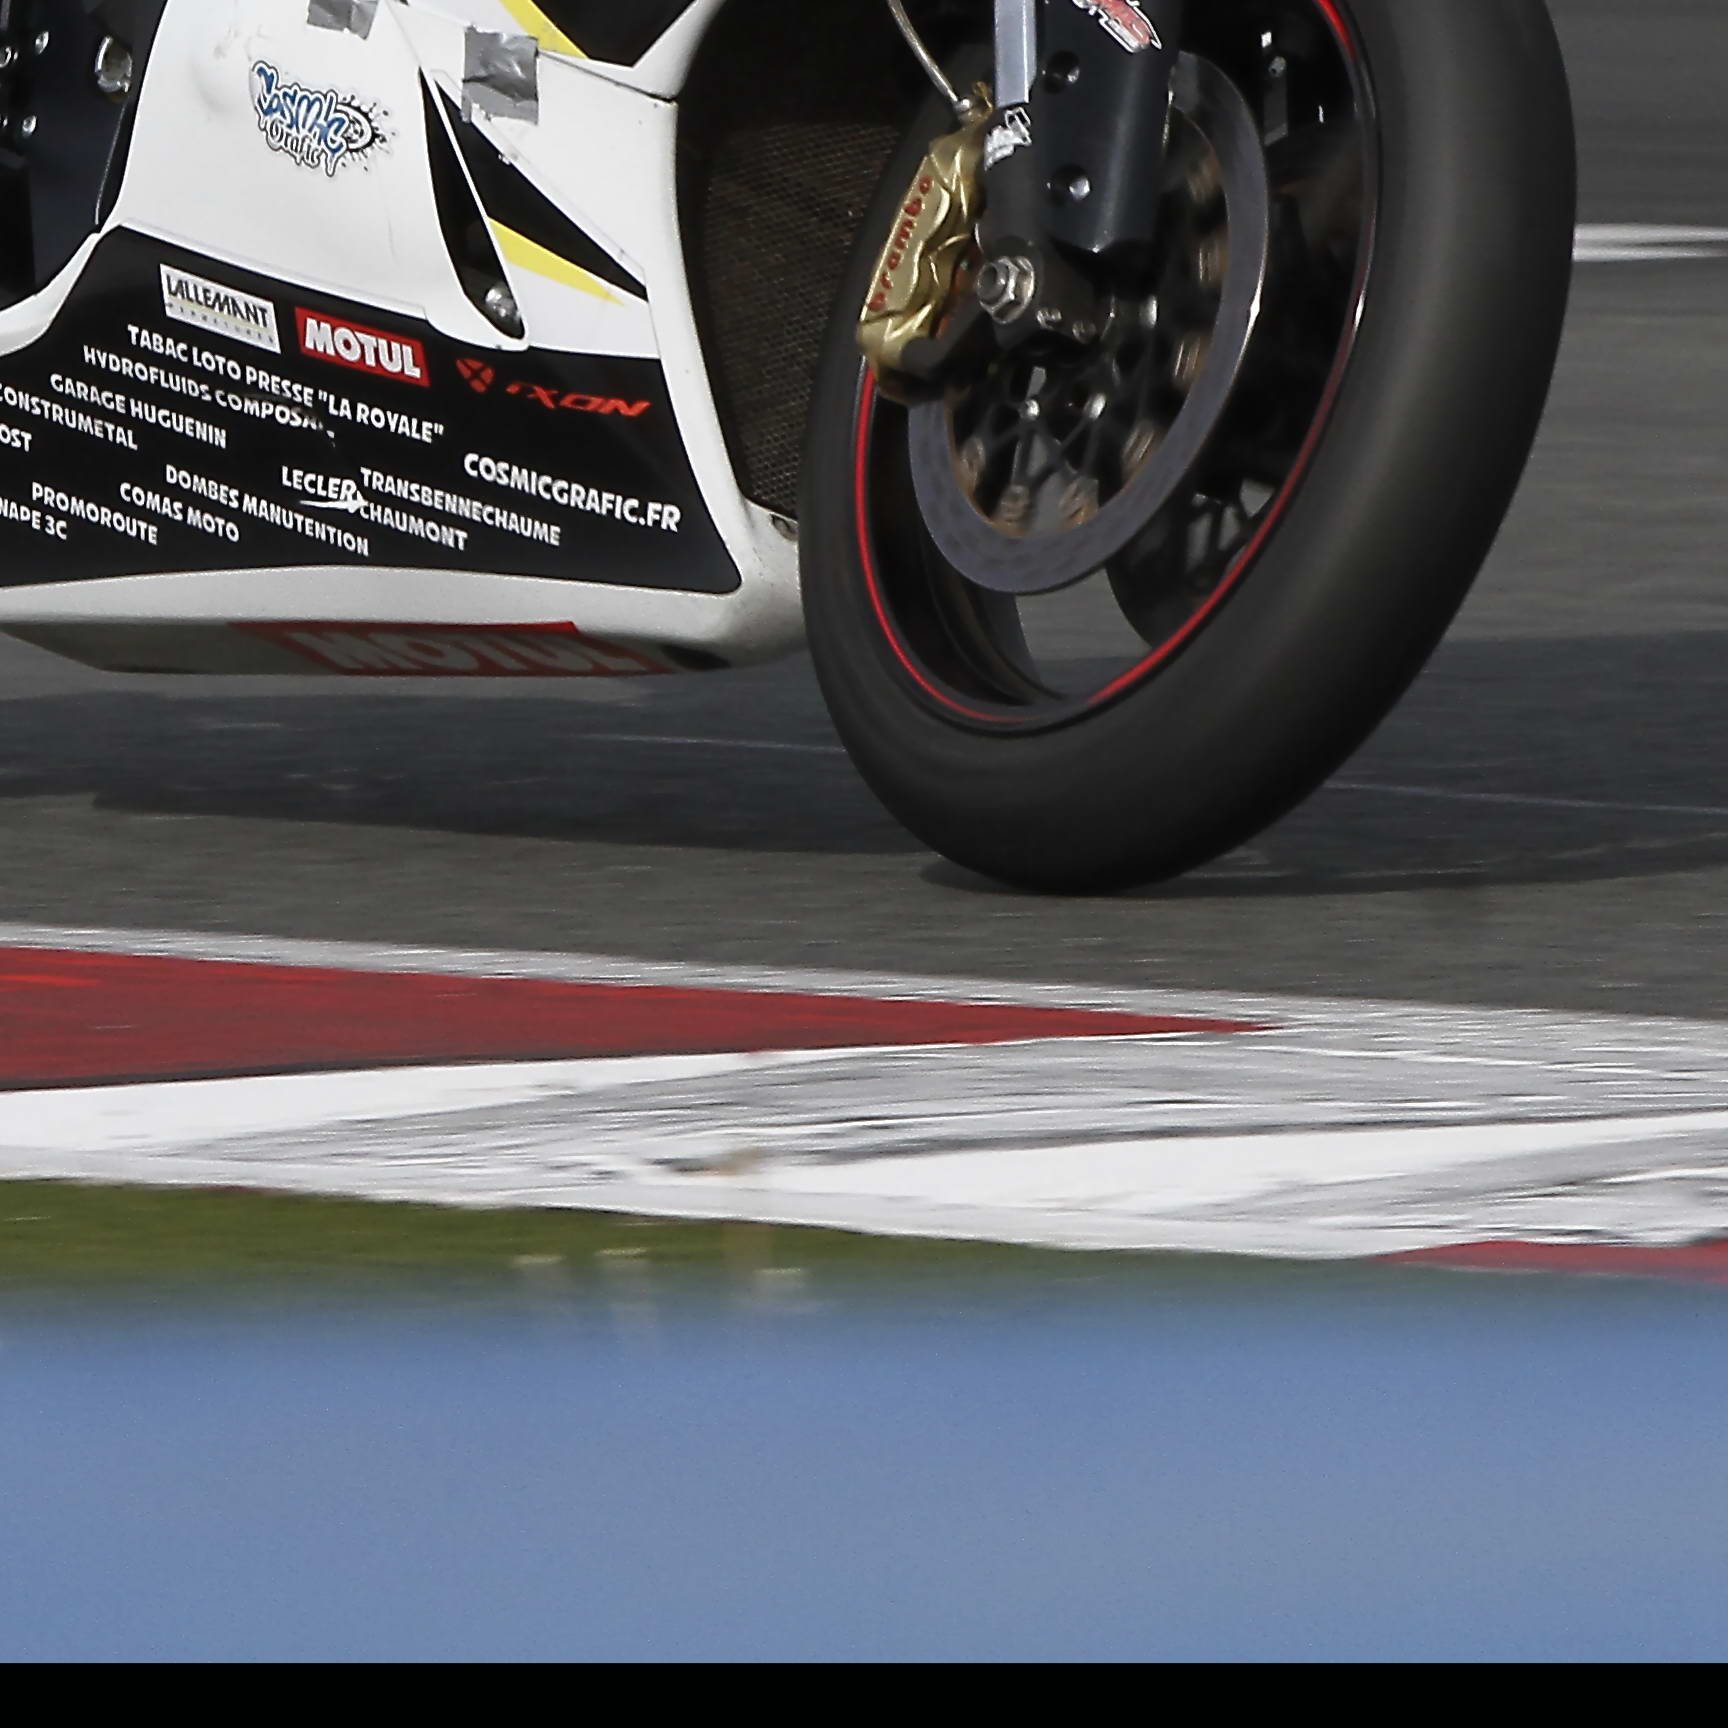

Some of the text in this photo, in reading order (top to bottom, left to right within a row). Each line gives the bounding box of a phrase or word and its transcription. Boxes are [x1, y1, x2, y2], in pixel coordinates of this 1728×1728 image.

[867, 174, 932, 312] brembo
[166, 275, 270, 327] LALLEMANT
[126, 323, 189, 363] TABAC
[191, 346, 242, 381] LOTO
[245, 365, 315, 408] PRESSE
[304, 317, 423, 379] MOTUL
[49, 373, 227, 450] GARAGE HUGUENIN
[31, 481, 160, 546] PROMOROUTE
[44, 514, 68, 541] 3C
[119, 482, 241, 543] COMAS MOTO
[165, 464, 370, 558] DOMBES MANUTENTION
[359, 499, 469, 551] CHAUMONT
[360, 466, 562, 547] TRANSBENNECHAUME
[463, 452, 682, 533] COSMICGRAFIC.FR
